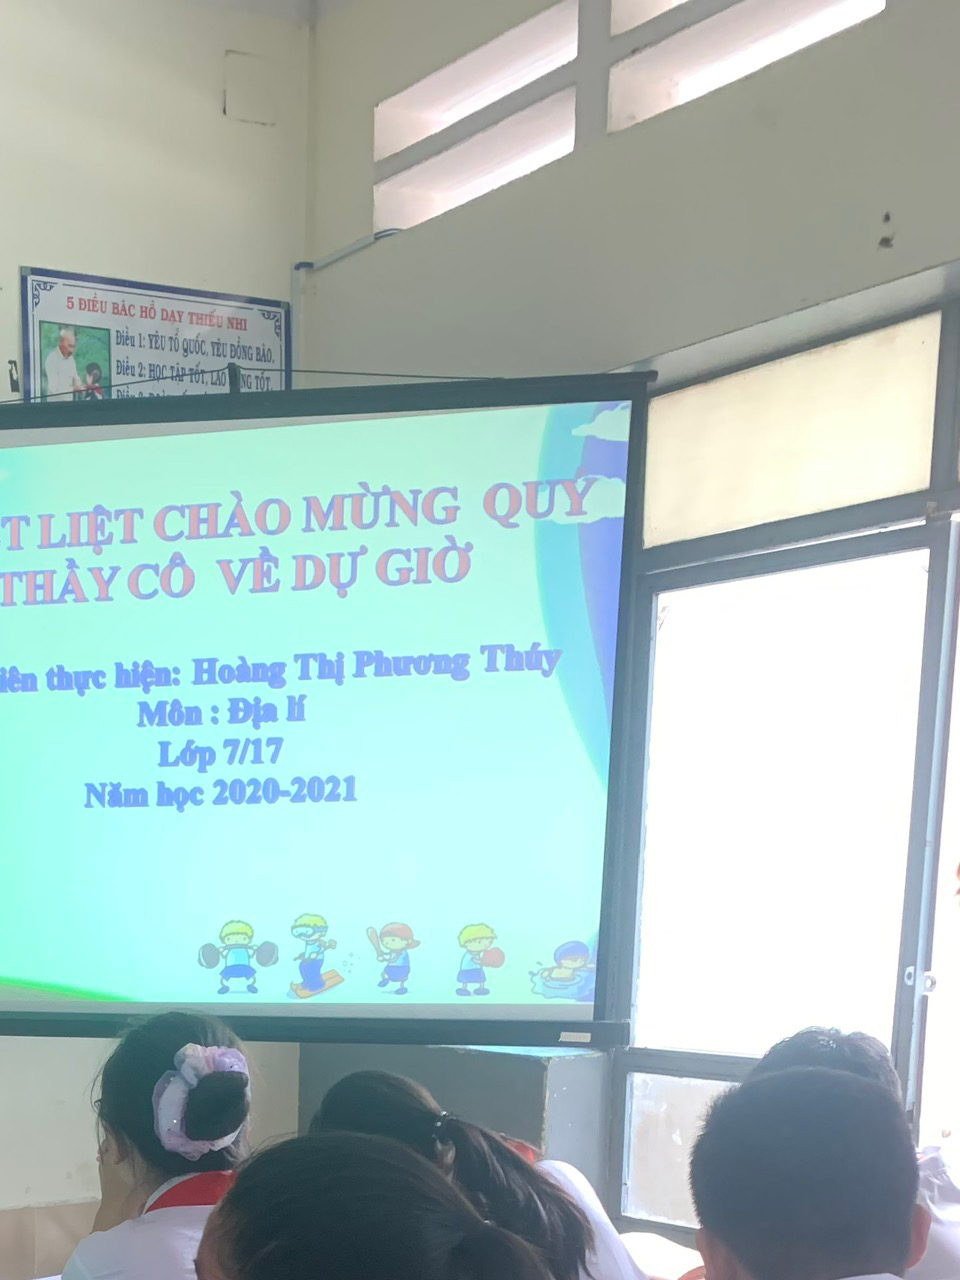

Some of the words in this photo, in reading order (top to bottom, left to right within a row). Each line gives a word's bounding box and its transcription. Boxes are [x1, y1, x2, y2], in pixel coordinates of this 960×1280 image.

[66, 296, 75, 310] 5
[78, 292, 108, 314] ĐIỀU
[111, 299, 136, 318] BÁC
[139, 299, 157, 320] HỒ
[160, 308, 185, 325] DẠY
[187, 309, 224, 328] THIẾU
[226, 316, 248, 331] NHI
[115, 326, 136, 348] Điều
[138, 333, 146, 349] 1:
[148, 330, 166, 351] YÊU
[168, 327, 180, 353] TỔ
[211, 338, 228, 358] YÊU
[229, 335, 253, 361] ĐỒNG
[115, 355, 136, 377] Điều
[148, 363, 168, 383] HỌC
[210, 369, 227, 387] LAO
[240, 373, 252, 390] NG
[36, 504, 144, 556] LIỆT
[153, 490, 292, 541] CHÀO
[301, 481, 461, 533] MỪNG
[127, 551, 195, 600] CÔ
[216, 546, 281, 595] VỀ
[291, 545, 369, 599] DỰ
[375, 534, 474, 587] GIỜ
[46, 664, 107, 697] thực
[114, 659, 181, 694] hiện:
[191, 655, 287, 689] Hoàng
[293, 651, 345, 686] Thị
[352, 650, 470, 681] Phương
[479, 642, 563, 678] Thúy
[136, 698, 203, 728] Môn
[227, 696, 278, 730] Địa
[286, 694, 308, 722] lí
[157, 739, 216, 774] Lớp
[222, 737, 284, 766] 7/17
[84, 782, 149, 809] Năm
[156, 781, 205, 813] học
[212, 774, 358, 806] 2020-2021
